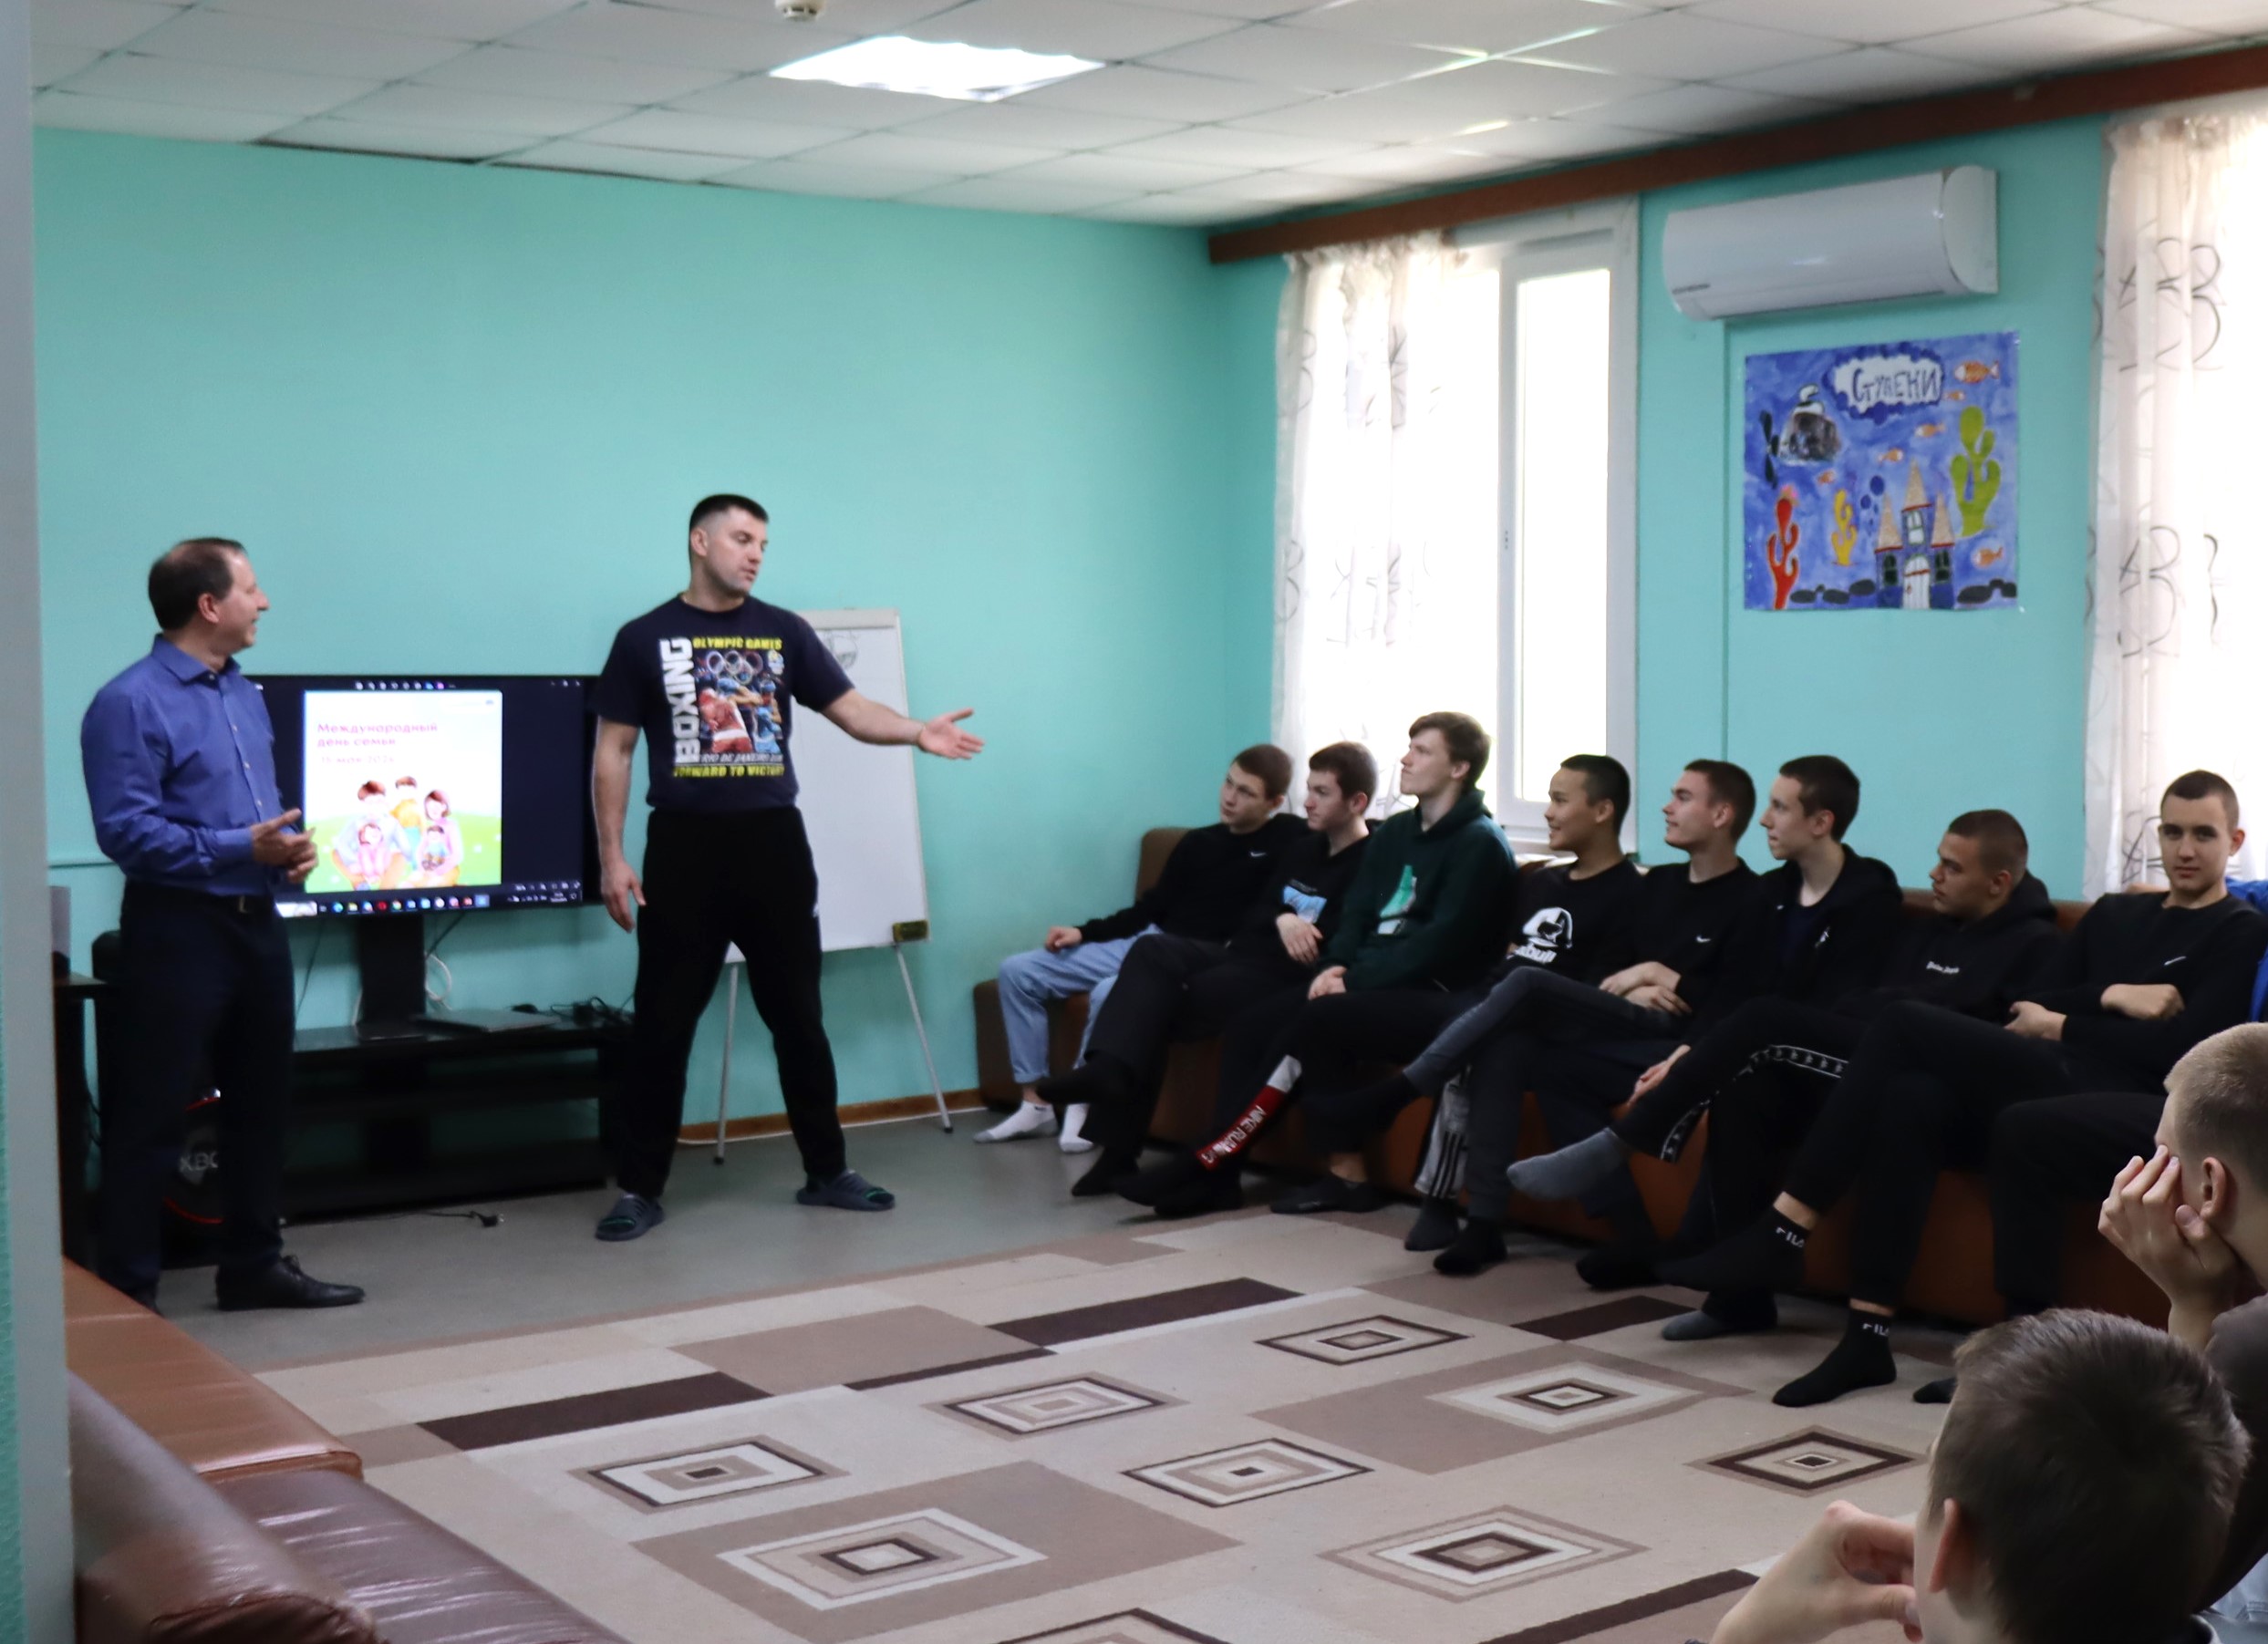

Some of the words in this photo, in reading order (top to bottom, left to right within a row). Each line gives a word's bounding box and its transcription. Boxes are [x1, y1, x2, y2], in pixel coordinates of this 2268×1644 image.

[692, 636, 744, 649] OLYMPIC
[746, 638, 782, 650] GAMES
[659, 636, 701, 763] BOXING
[317, 722, 438, 734] Международный
[317, 738, 350, 748] день
[354, 738, 396, 747] семьи
[730, 765, 745, 776] TO
[1240, 1104, 1267, 1133] NIKE
